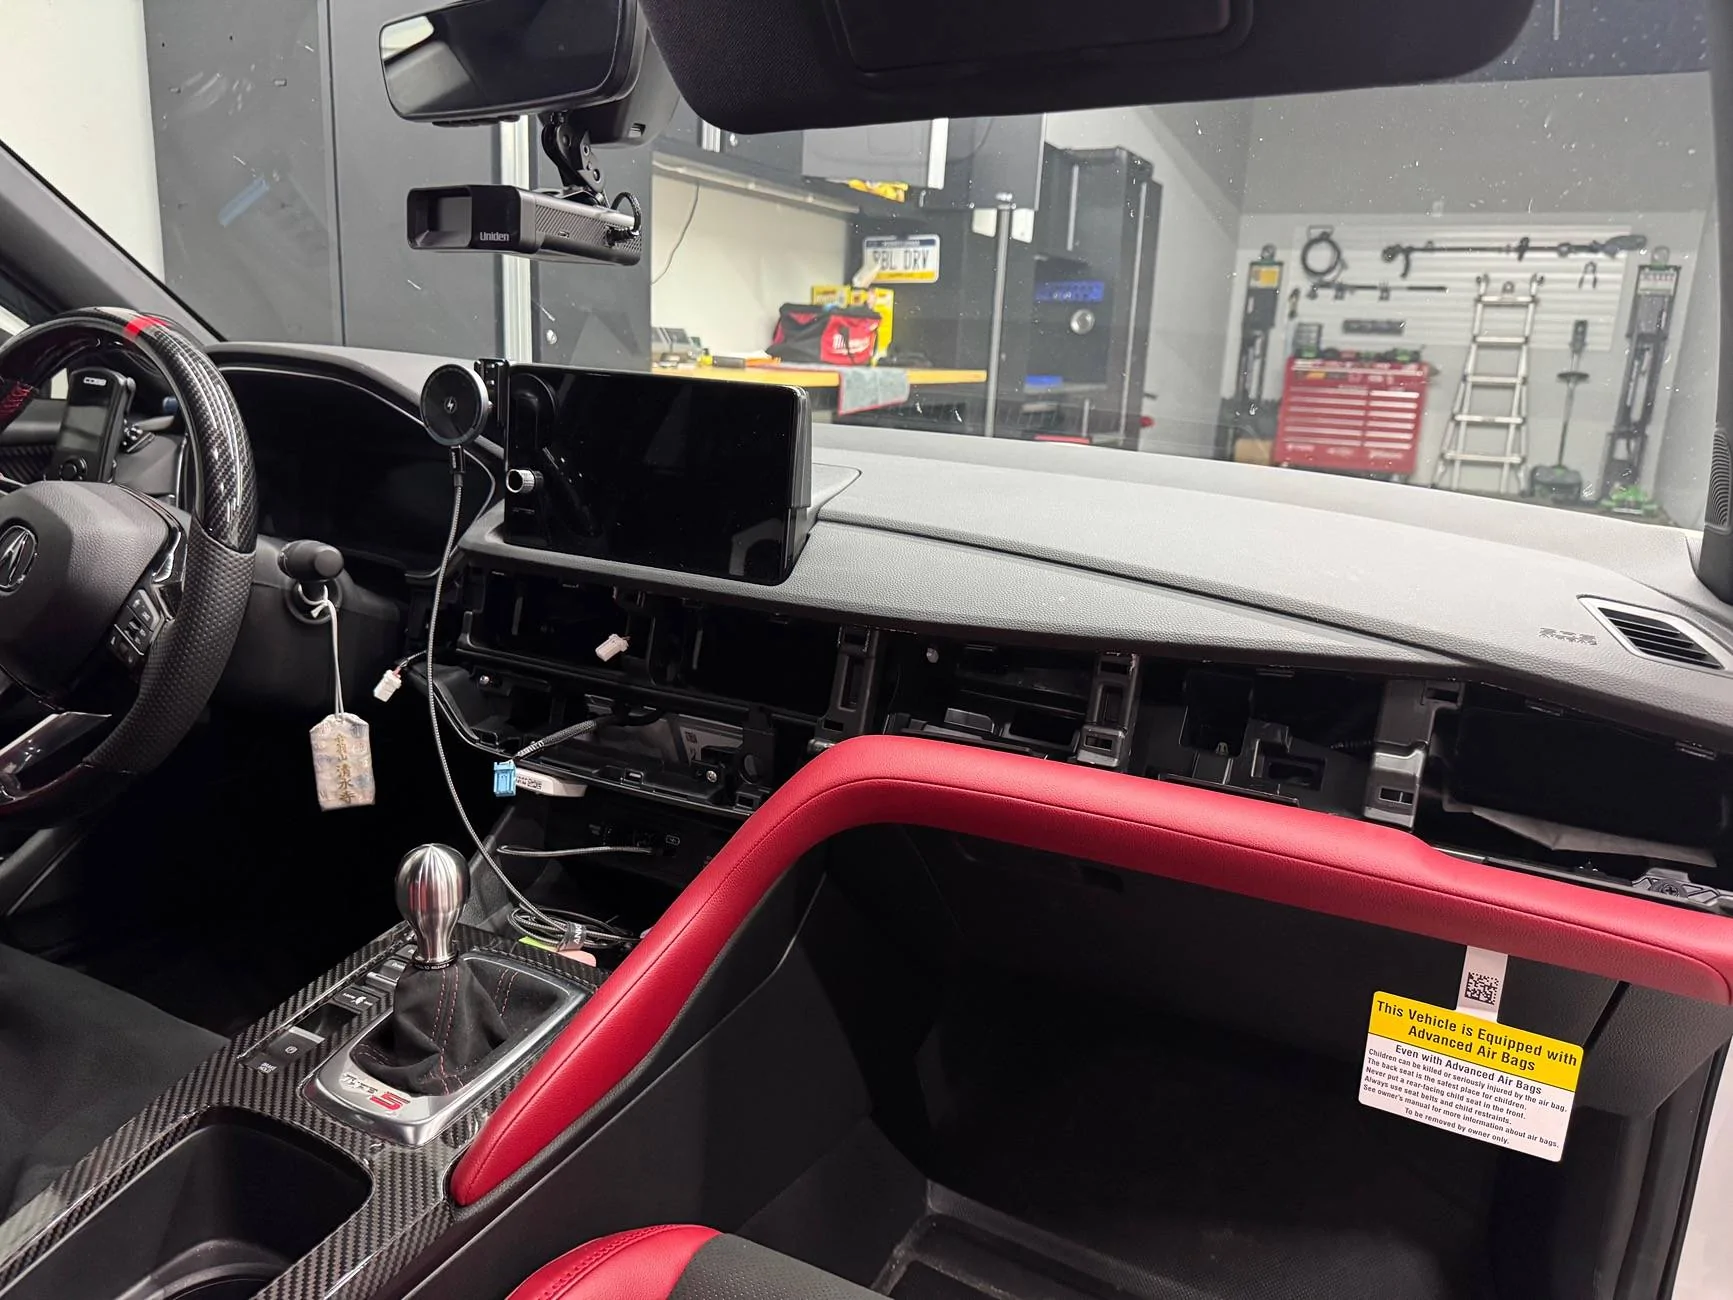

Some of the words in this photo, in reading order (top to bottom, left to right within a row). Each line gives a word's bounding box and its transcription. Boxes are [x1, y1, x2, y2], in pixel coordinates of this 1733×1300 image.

[480, 231, 510, 242] Uniden
[1378, 1000, 1403, 1017] This
[1409, 1009, 1456, 1032] Vehicle
[1462, 1024, 1473, 1036] is
[1478, 1028, 1542, 1056] Equipped
[1547, 1050, 1577, 1066] with
[1408, 1026, 1472, 1053] Advanced
[1477, 1046, 1497, 1059] Air
[1502, 1052, 1535, 1070] Bags
[342, 1073, 378, 1095] TYPE
[370, 1092, 410, 1111] S
[1366, 1067, 1386, 1077] Never
[1388, 1074, 1399, 1082] put
[1406, 1080, 1444, 1096] rear-facing
[1447, 1090, 1464, 1101] child
[1466, 1097, 1481, 1106] seat
[1492, 1104, 1504, 1113] the
[1506, 1108, 1526, 1119] front.
[1368, 1058, 1380, 1066] The
[1382, 1062, 1398, 1072] back
[1400, 1068, 1414, 1077] seat
[1424, 1075, 1436, 1083] the
[1437, 1079, 1458, 1090] safest
[1461, 1086, 1480, 1097] place
[1494, 1095, 1527, 1110] children.
[1369, 1049, 1396, 1062] Children
[1412, 1061, 1420, 1069] be
[1423, 1063, 1441, 1075] killed
[1453, 1075, 1485, 1089] seriously
[1487, 1083, 1512, 1096] injured
[1514, 1091, 1523, 1100] by
[1525, 1094, 1536, 1103] the
[1538, 1098, 1549, 1106] air
[1551, 1101, 1567, 1112] bag.
[1396, 1045, 1418, 1058] Even
[1422, 1053, 1442, 1065] with
[1445, 1060, 1494, 1081] Advanced
[1497, 1075, 1513, 1086] Air
[1516, 1080, 1542, 1095] Bags
[1364, 1084, 1376, 1093] See
[1378, 1090, 1403, 1102] owner's
[1405, 1098, 1430, 1110] manual
[1432, 1105, 1441, 1113] for
[1443, 1110, 1461, 1119] more
[1463, 1113, 1504, 1131] information
[1505, 1128, 1526, 1138] about
[1528, 1133, 1538, 1141] air
[1539, 1137, 1559, 1148] bags.
[1365, 1076, 1388, 1088] Always
[1404, 1087, 1419, 1097] seat
[1421, 1093, 1438, 1102] belts
[1440, 1098, 1453, 1108] and
[1455, 1102, 1472, 1113] child
[1475, 1110, 1512, 1125] restraints.
[1425, 1115, 1455, 1128] removed
[1458, 1123, 1466, 1132] by
[1468, 1127, 1490, 1139] owner
[1492, 1135, 1509, 1144] only.
